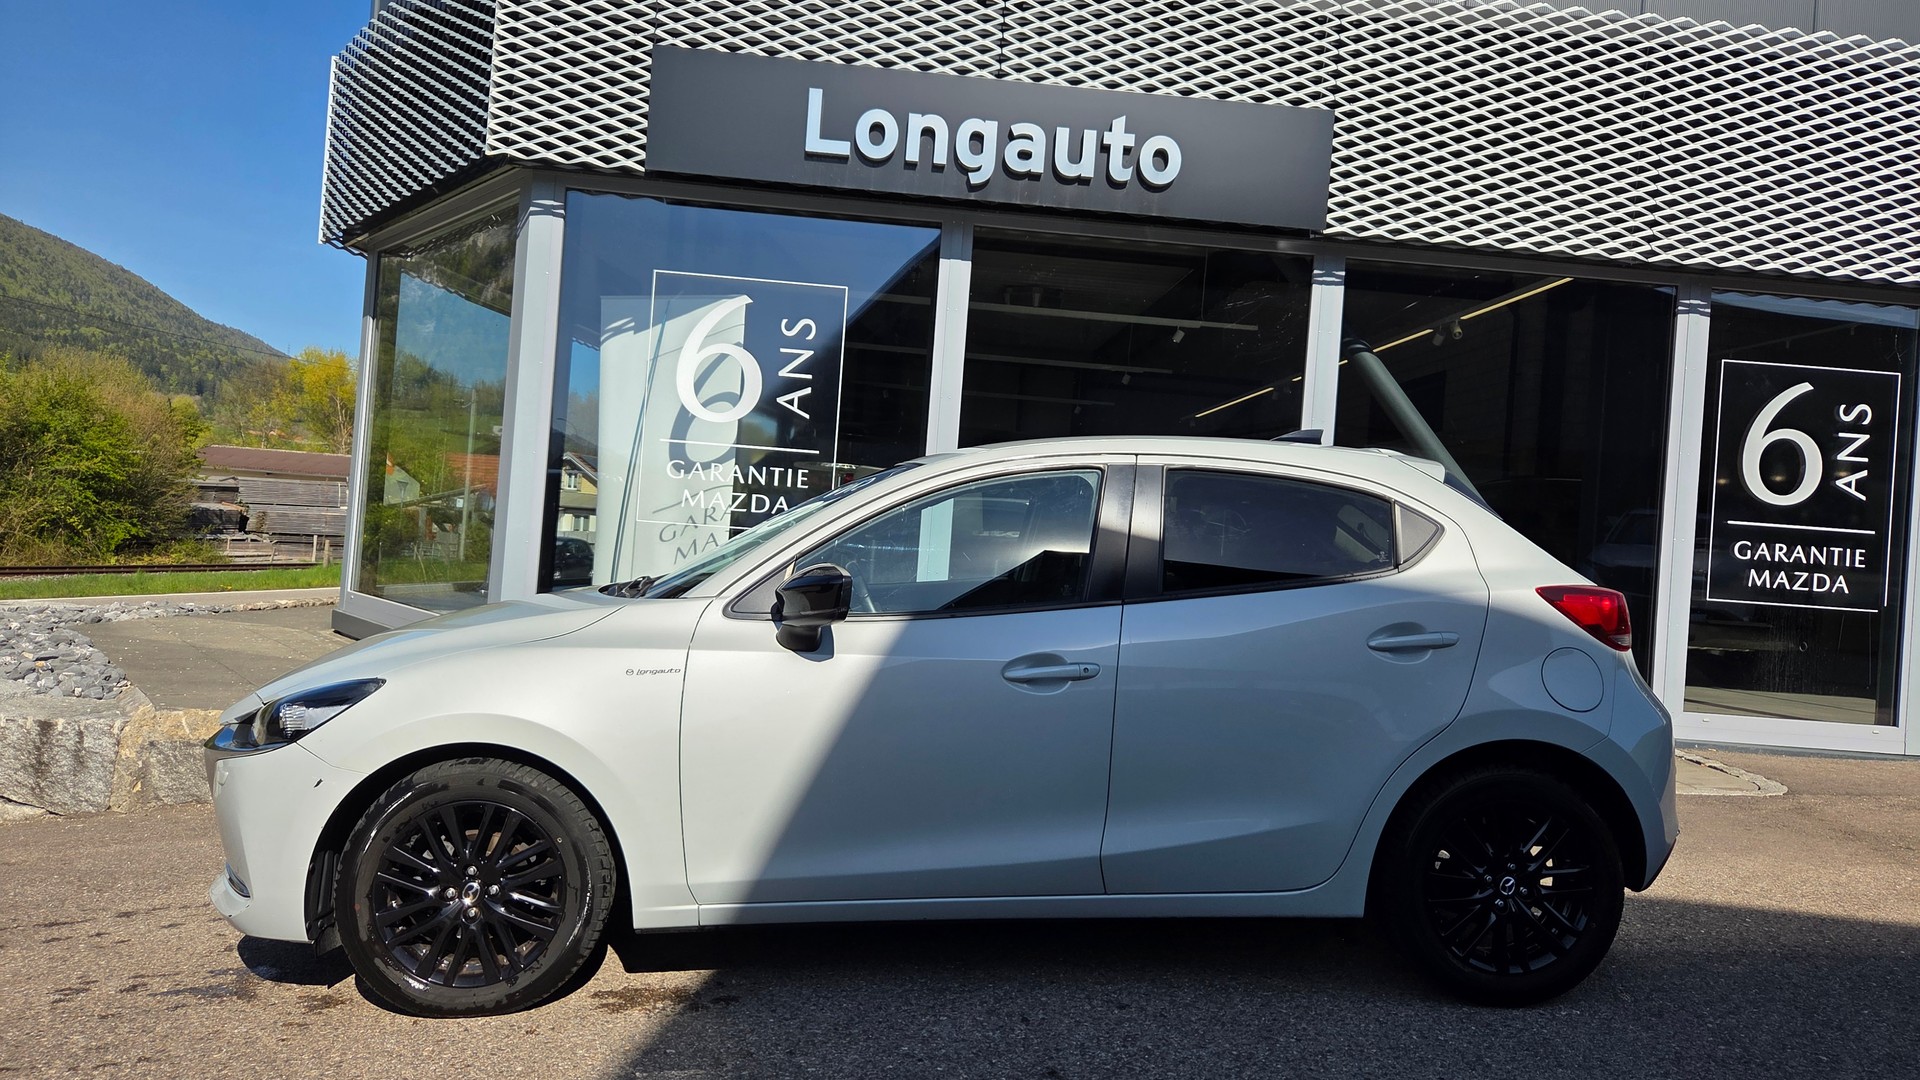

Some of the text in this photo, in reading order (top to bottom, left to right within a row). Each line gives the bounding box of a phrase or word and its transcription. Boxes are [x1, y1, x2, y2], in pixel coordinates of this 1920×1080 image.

[804, 87, 1183, 187] Longauto
[676, 294, 817, 423] 6 ANS
[1742, 381, 1873, 506] 6 ANS
[665, 459, 810, 489] GARANTIE
[680, 488, 789, 515] MAZDA
[1733, 540, 1866, 569] GARANTIE
[1747, 568, 1850, 595] MAZDA
